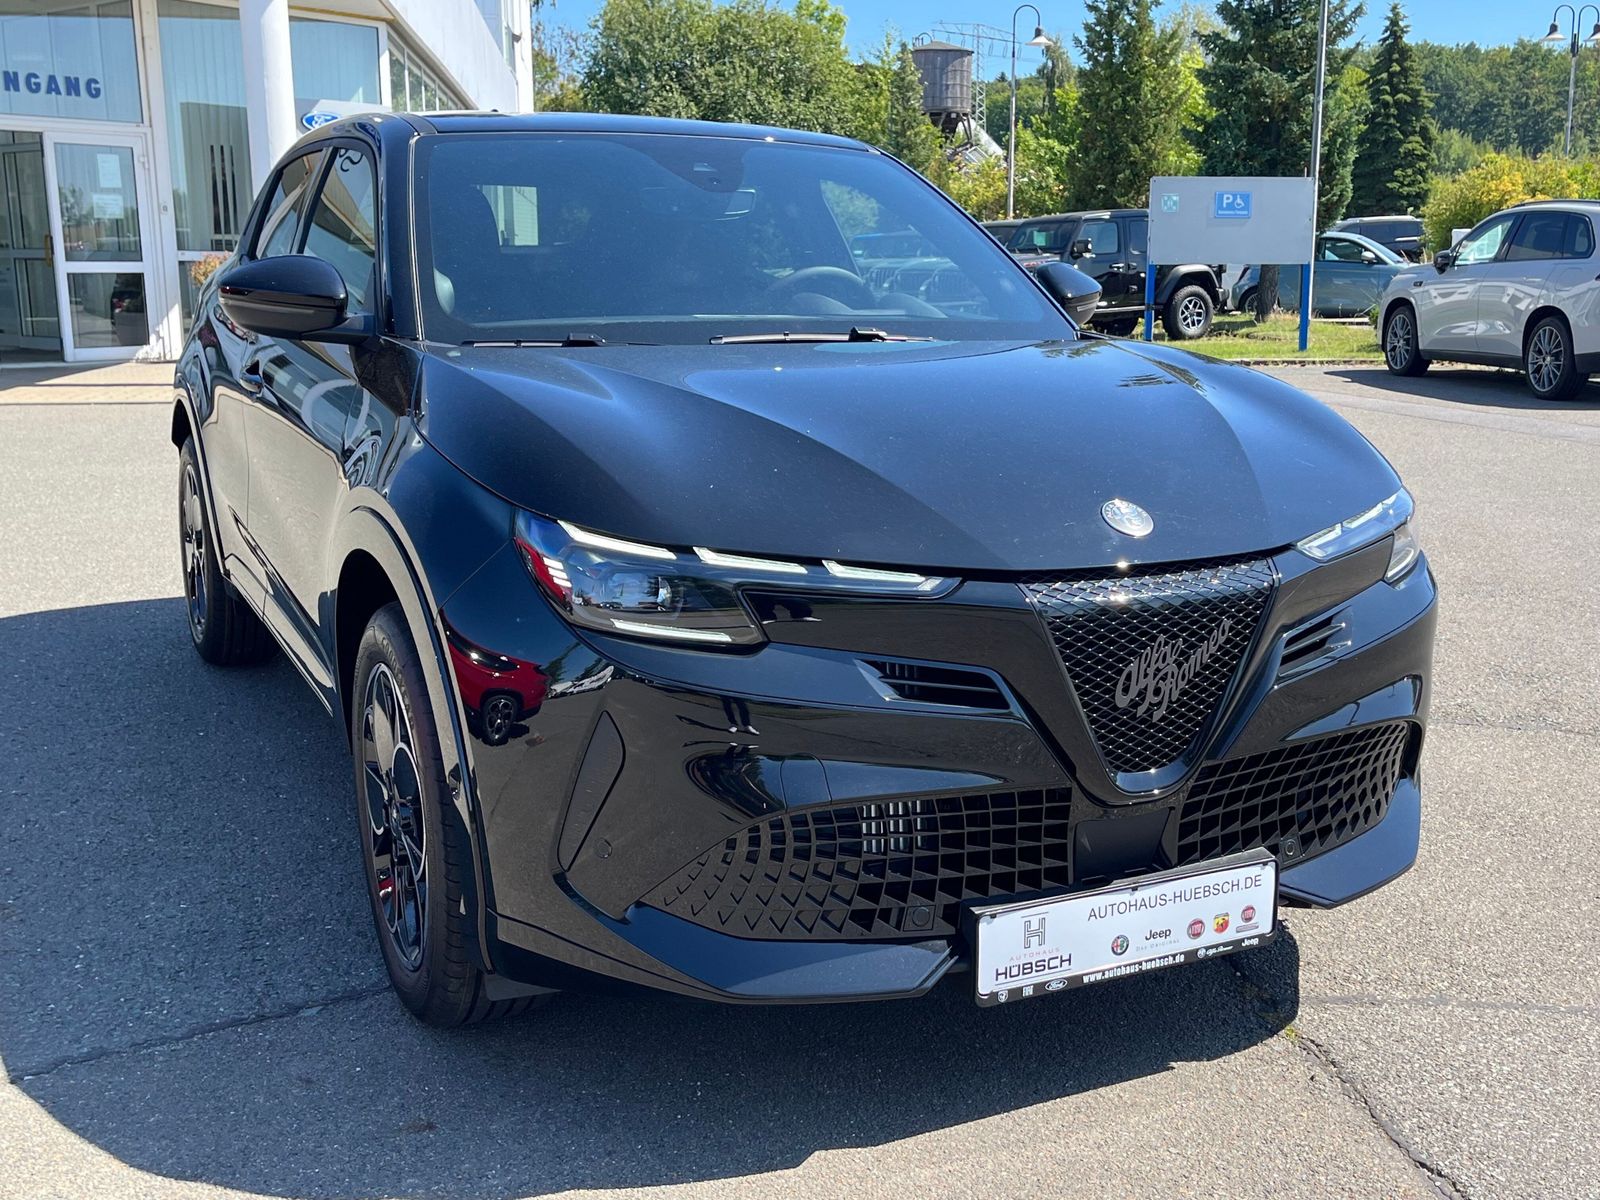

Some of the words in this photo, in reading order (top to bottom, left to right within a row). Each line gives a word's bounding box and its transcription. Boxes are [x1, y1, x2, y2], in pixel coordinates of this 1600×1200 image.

[2, 70, 101, 99] NGANG
[1222, 193, 1233, 208] P
[1150, 618, 1232, 723] Romeo
[1087, 874, 1262, 922] AUTOHAUS-HUEBSCH.DE
[1144, 927, 1172, 942] Jeep
[1241, 937, 1259, 947] Jeep
[995, 953, 1072, 982] HÜBSCH
[1009, 947, 1061, 962] AUTOHAUS
[1082, 953, 1185, 984] www.autohaus-huebsch.de
